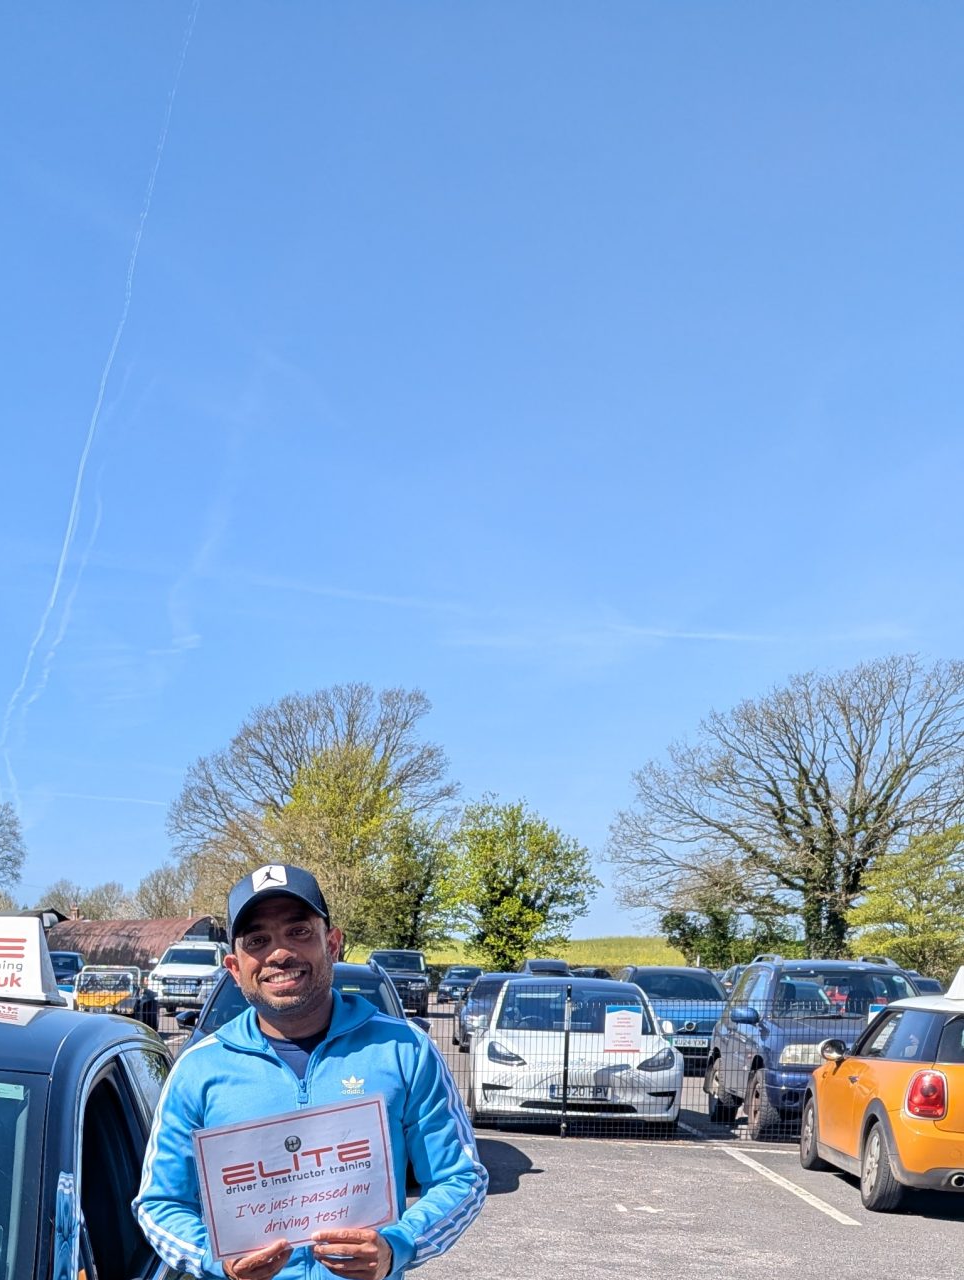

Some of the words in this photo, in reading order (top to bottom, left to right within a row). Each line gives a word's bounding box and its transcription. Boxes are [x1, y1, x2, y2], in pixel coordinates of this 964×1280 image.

[221, 1139, 372, 1186] ELITE
[226, 1182, 257, 1195] driver
[261, 1179, 268, 1188] &
[271, 1168, 325, 1186] instructor
[330, 1160, 371, 1175] training
[236, 1203, 266, 1219] I've
[268, 1195, 297, 1215] just
[300, 1182, 349, 1208] passed
[352, 1181, 371, 1195] my
[264, 1214, 310, 1234] driving
[315, 1206, 349, 1222] test!
